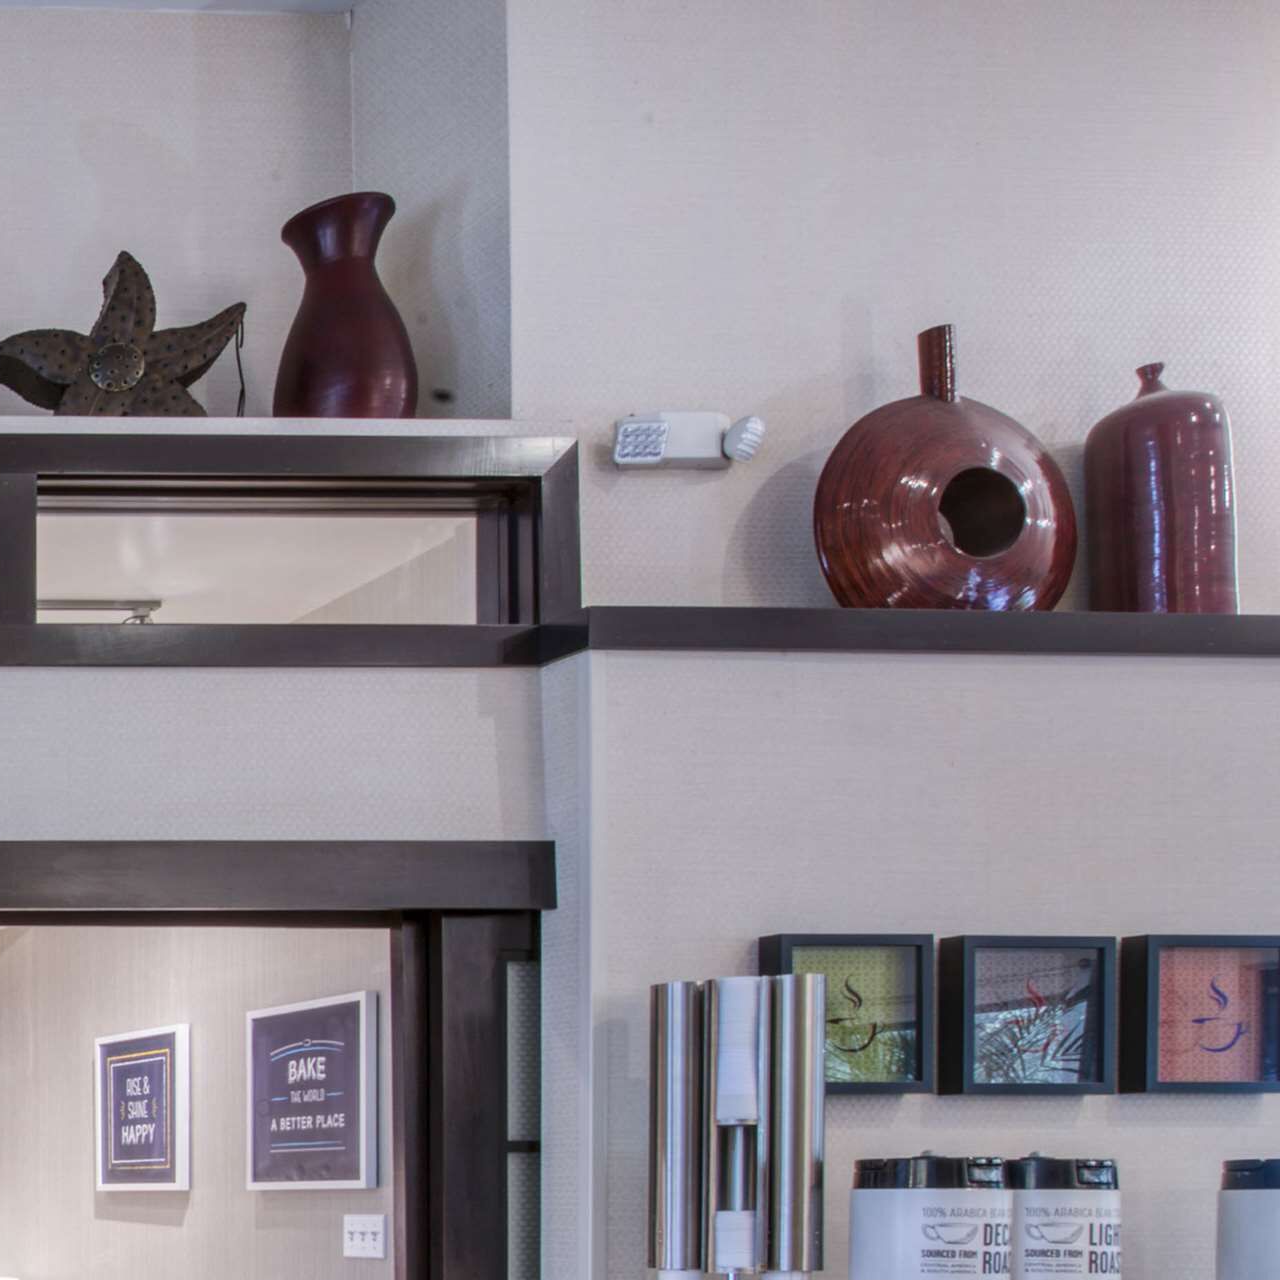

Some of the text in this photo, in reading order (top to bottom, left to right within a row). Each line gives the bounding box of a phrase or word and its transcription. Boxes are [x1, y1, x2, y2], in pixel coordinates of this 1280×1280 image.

[288, 1056, 327, 1084] BAKE
[126, 1075, 151, 1096] RISE &
[290, 1088, 326, 1103] THE WORLD
[127, 1099, 148, 1119] SHINE
[270, 1113, 345, 1132] A BETTER PLACE
[121, 1123, 155, 1145] HAPPY
[922, 1207, 946, 1218] 100%
[950, 1207, 987, 1218] ARABICA
[1025, 1207, 1050, 1218] 100%
[1054, 1207, 1092, 1218] ARABICA
[921, 1249, 978, 1259] SOURCED FROM
[1024, 1248, 1083, 1259] SOURCED FROM
